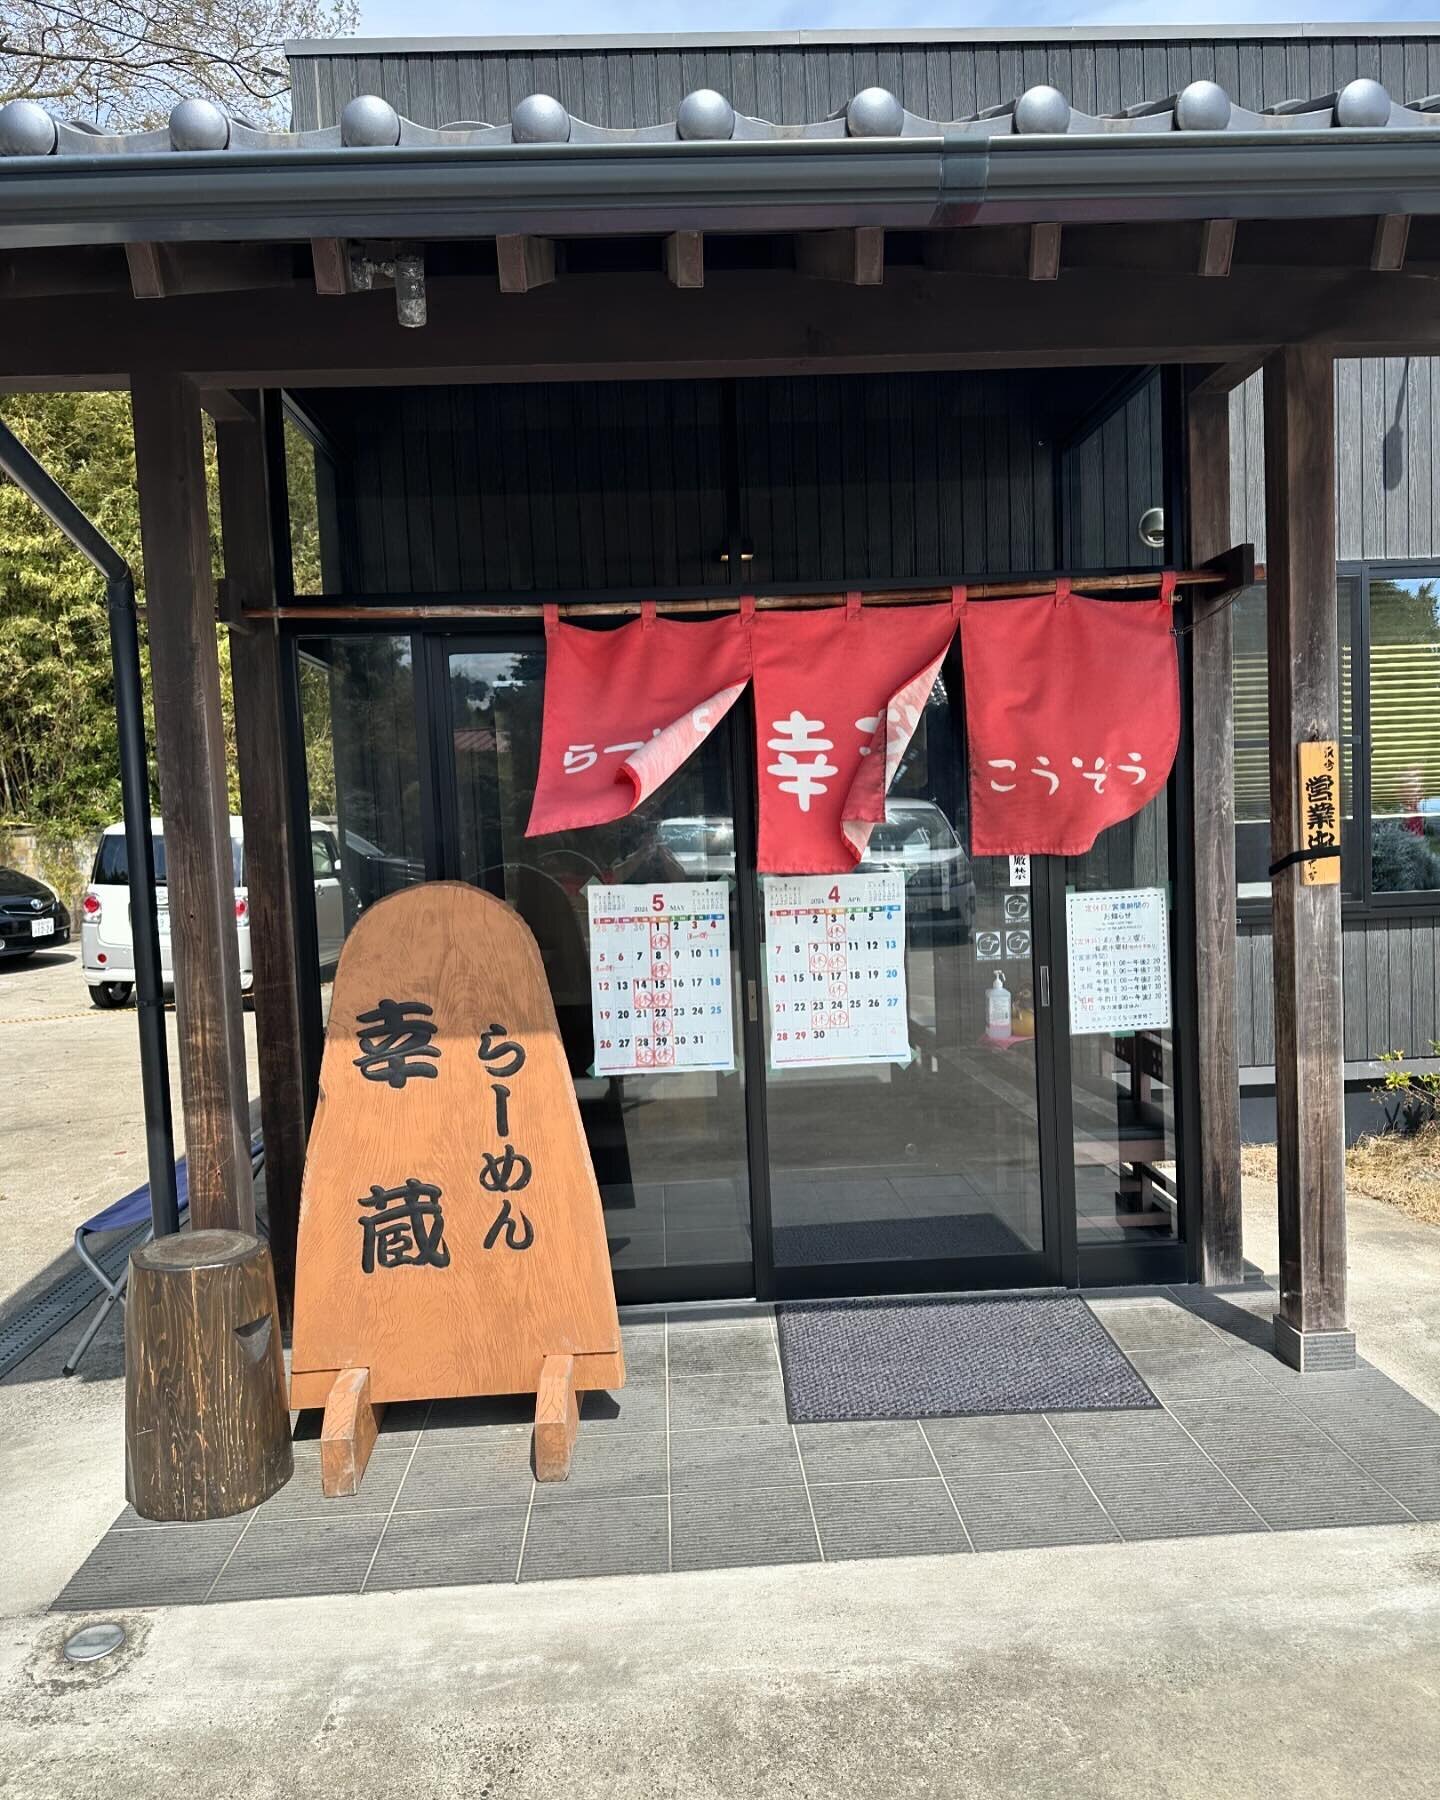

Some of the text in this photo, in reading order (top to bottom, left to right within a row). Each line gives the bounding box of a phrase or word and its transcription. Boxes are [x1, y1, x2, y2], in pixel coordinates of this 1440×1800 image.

[987, 751, 1149, 797] こうぞう
[828, 885, 841, 903] 4
[652, 894, 665, 911] 5
[830, 941, 841, 951] 10
[849, 941, 859, 950] 11
[868, 941, 879, 949] 12
[887, 940, 897, 948] 13
[691, 948, 702, 957] 10
[710, 948, 719, 956] 11
[776, 969, 898, 982] 14 15 16 17 18 19 20
[599, 977, 721, 990] 12 13 14 15 16 17 18
[776, 997, 899, 1012] 21 22 23 24 25 26 27
[600, 1005, 722, 1019] 19 20 21 22 23 24 25
[601, 1035, 704, 1048] 26 27 28 29 30 31
[777, 1032, 788, 1040] 28
[795, 1031, 807, 1039] 29
[814, 1030, 825, 1038] 30
[477, 1023, 534, 1250] らーめん
